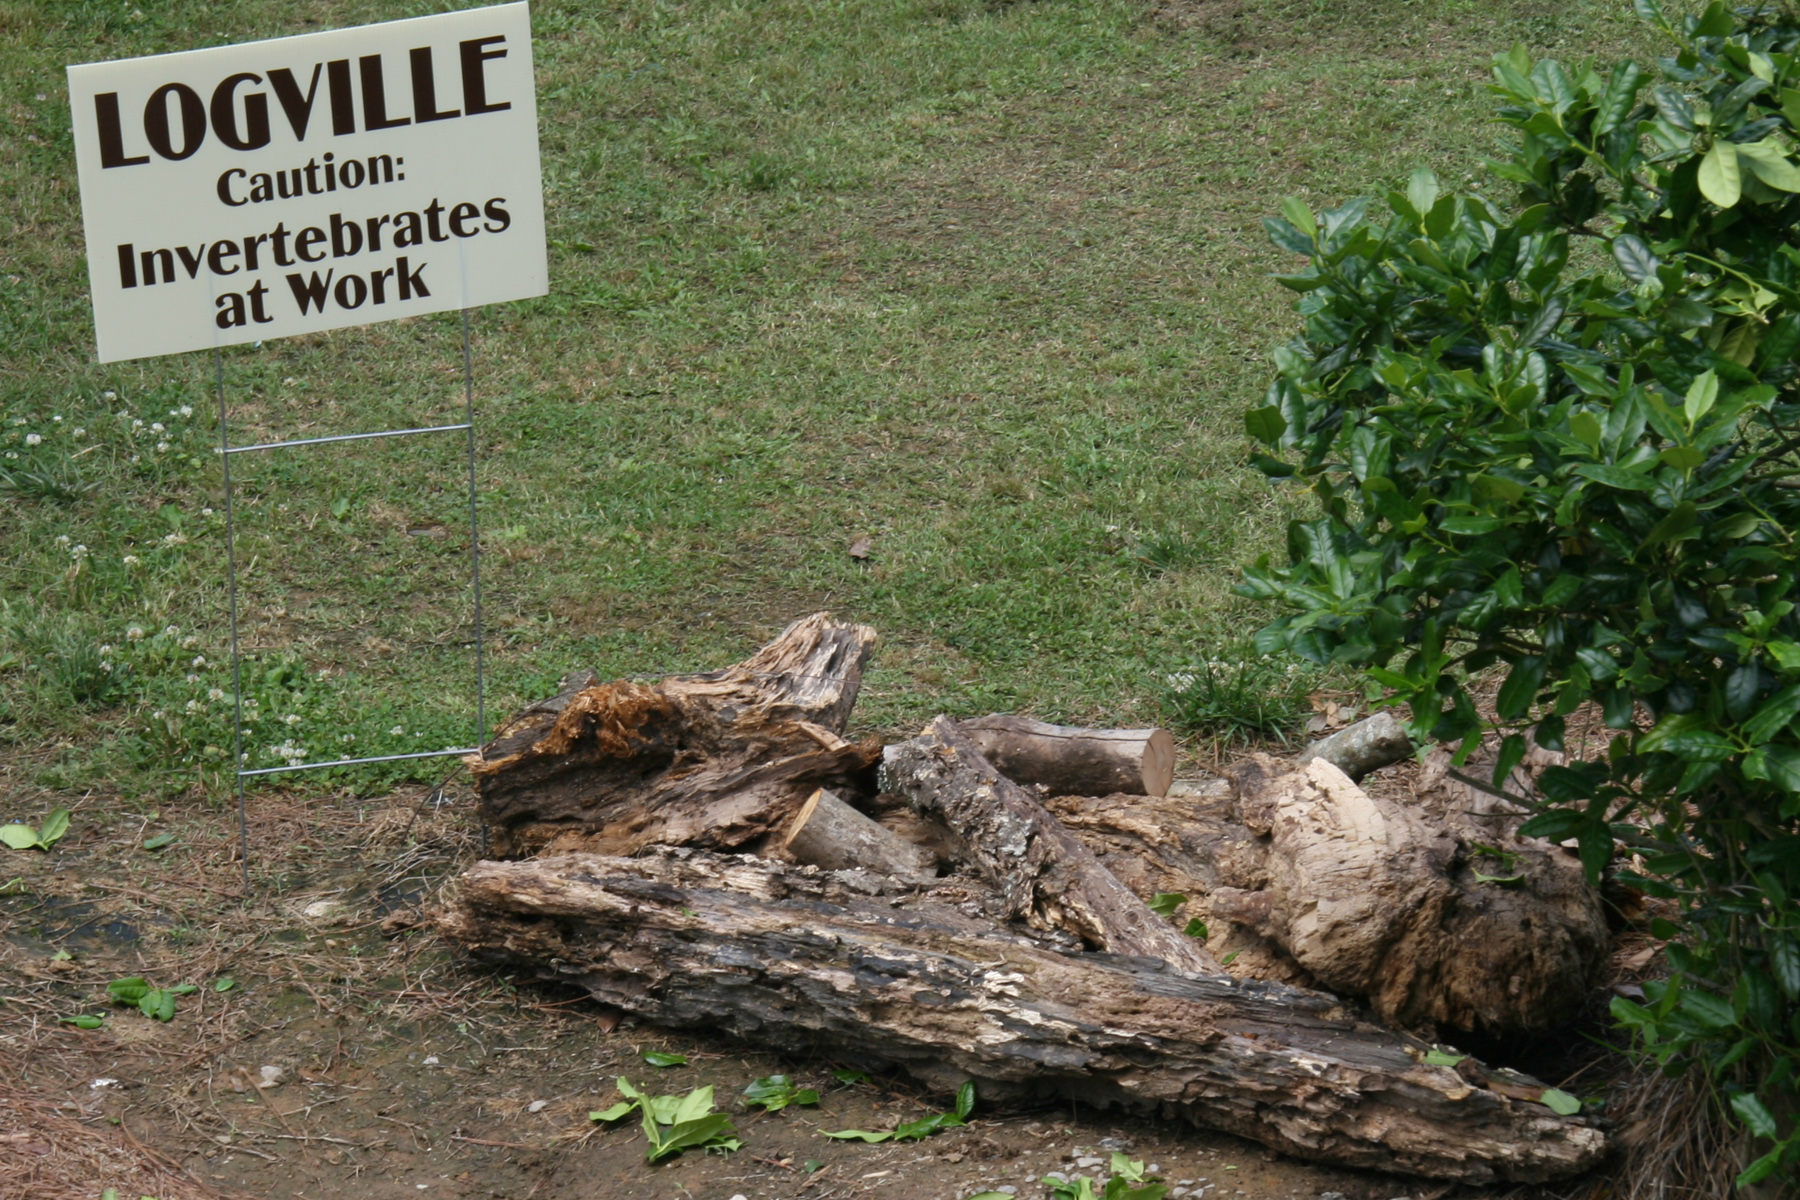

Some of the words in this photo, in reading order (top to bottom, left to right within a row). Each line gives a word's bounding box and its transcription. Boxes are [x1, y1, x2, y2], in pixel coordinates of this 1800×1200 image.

[94, 34, 512, 170] LOGVILLE
[216, 151, 405, 207] Caution:
[117, 197, 511, 289] Invertebrates
[215, 279, 274, 330] at
[285, 256, 431, 317] Work
